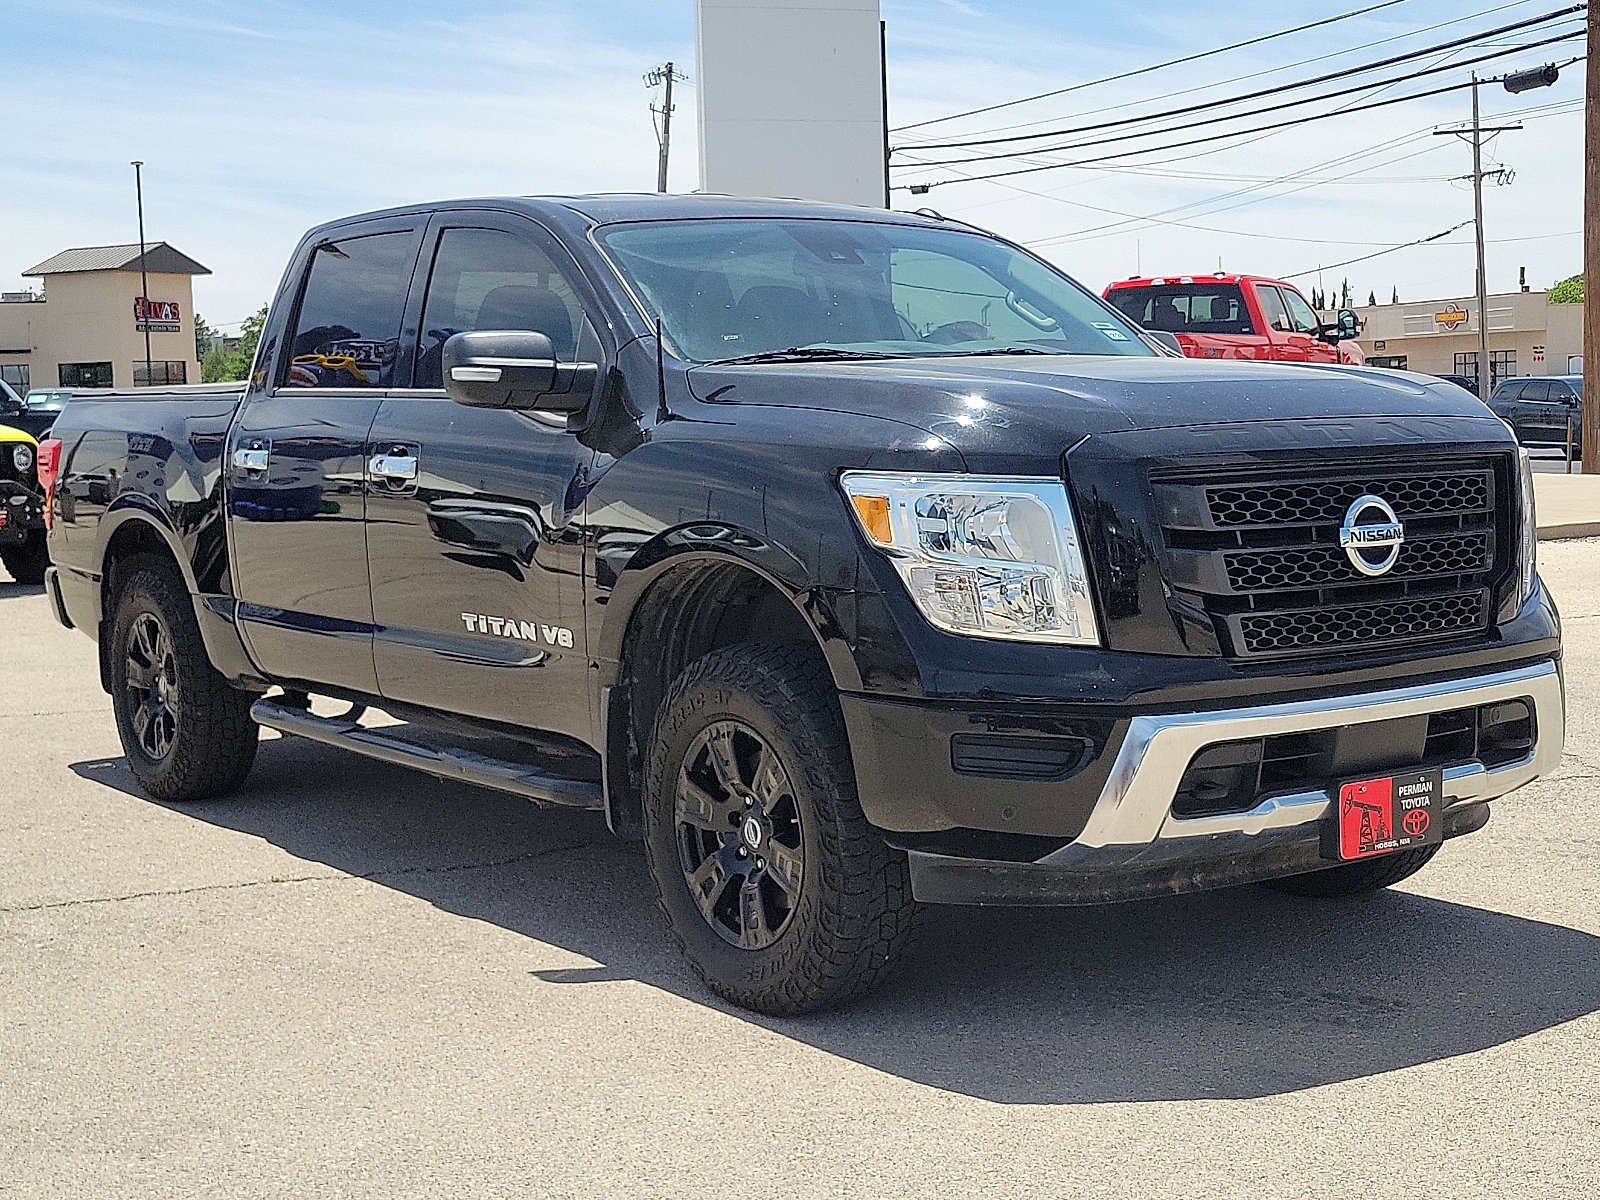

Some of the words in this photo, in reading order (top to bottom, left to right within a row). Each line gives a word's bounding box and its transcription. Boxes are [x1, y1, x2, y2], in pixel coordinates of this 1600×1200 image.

[1350, 528, 1402, 543] NISSAN
[461, 612, 537, 641] TITAN
[541, 624, 574, 648] V8
[1399, 781, 1433, 797] PERMIAN
[1401, 796, 1430, 810] TOYOTA
